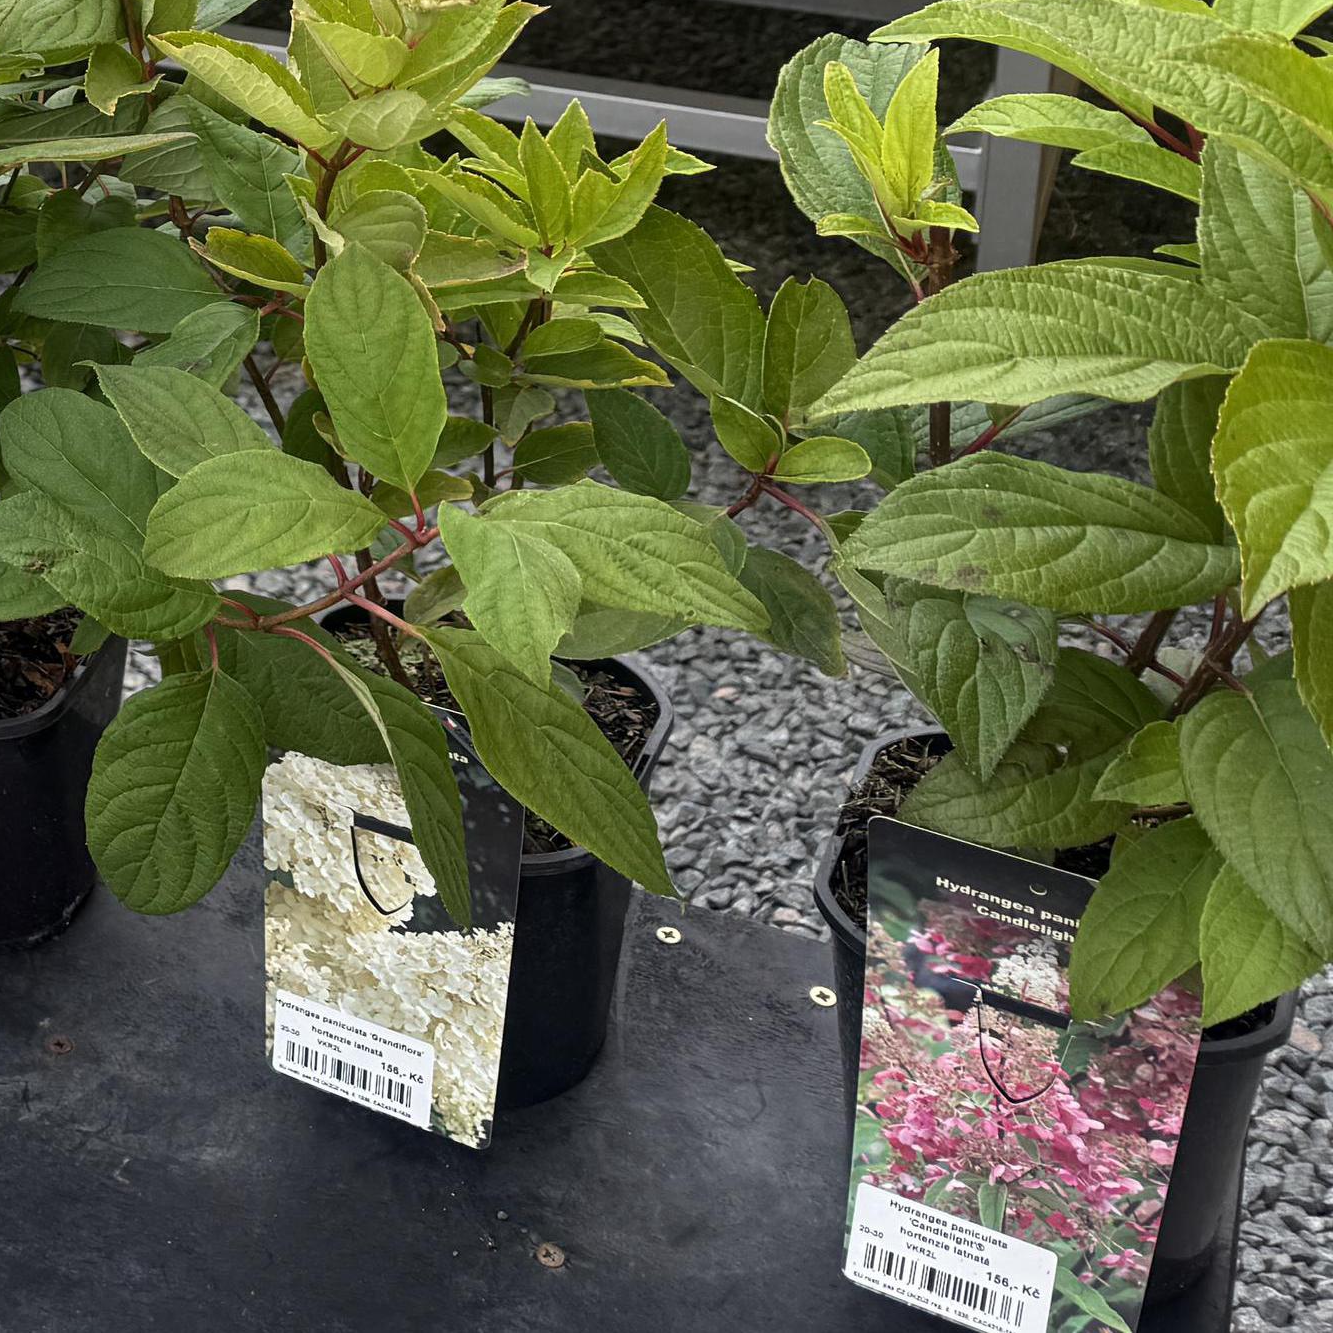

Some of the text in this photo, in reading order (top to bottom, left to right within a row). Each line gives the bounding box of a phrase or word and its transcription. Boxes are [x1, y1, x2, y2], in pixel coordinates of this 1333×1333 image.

[935, 876, 1035, 915] Hydrangea
[972, 903, 1075, 943] 'Candleligh
[311, 1025, 383, 1058] hortenzie latnatá
[323, 1014, 367, 1037] paniculata
[369, 1032, 425, 1058] 'Grandiflora'
[409, 1072, 424, 1084] Kč
[889, 1198, 1008, 1250] Hydrangea paniculata
[899, 1226, 990, 1267] hortenzie latnatá
[906, 1242, 937, 1260] VKR2L
[986, 1271, 1041, 1300] 156,- Kč
